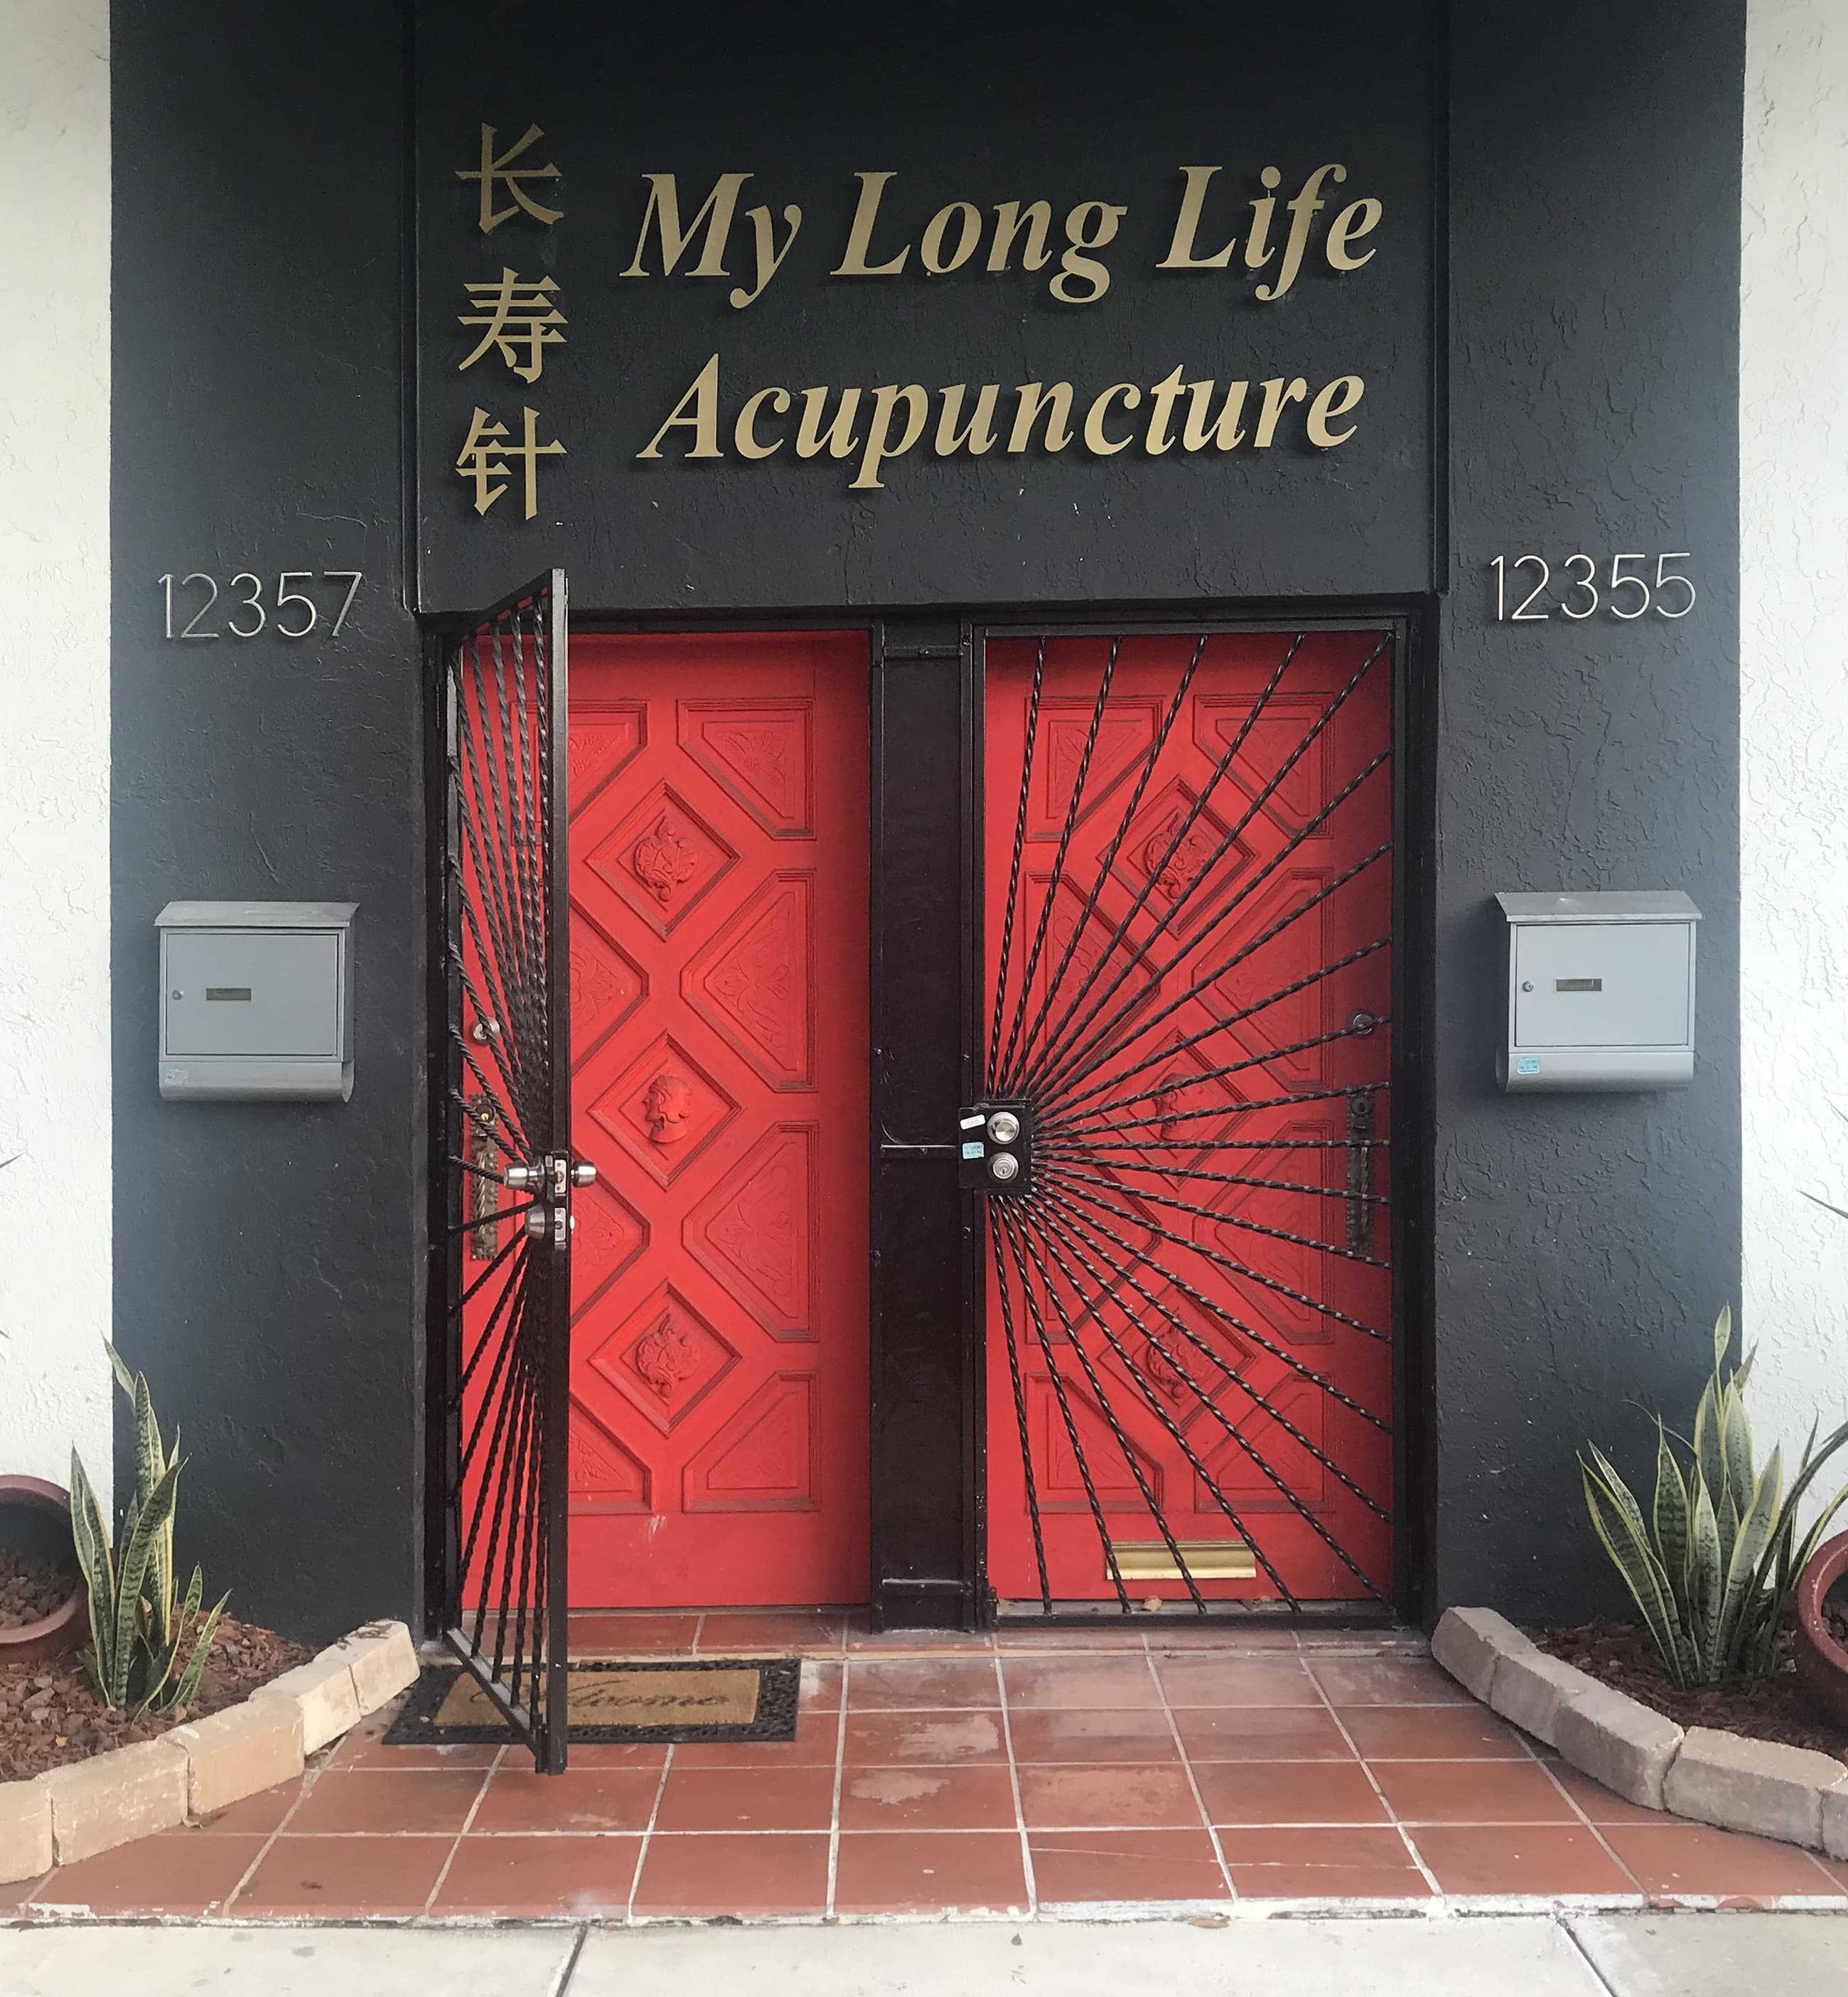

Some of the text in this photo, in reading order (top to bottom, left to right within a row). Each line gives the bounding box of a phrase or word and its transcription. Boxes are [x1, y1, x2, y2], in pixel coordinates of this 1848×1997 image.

[621, 163, 1384, 310] My Long Life
[454, 122, 569, 522] 长寿针
[635, 353, 1365, 490] Acupuncture
[157, 571, 363, 638] 12357
[1490, 552, 1697, 621] 12355
[468, 1679, 729, 1708] lcome
